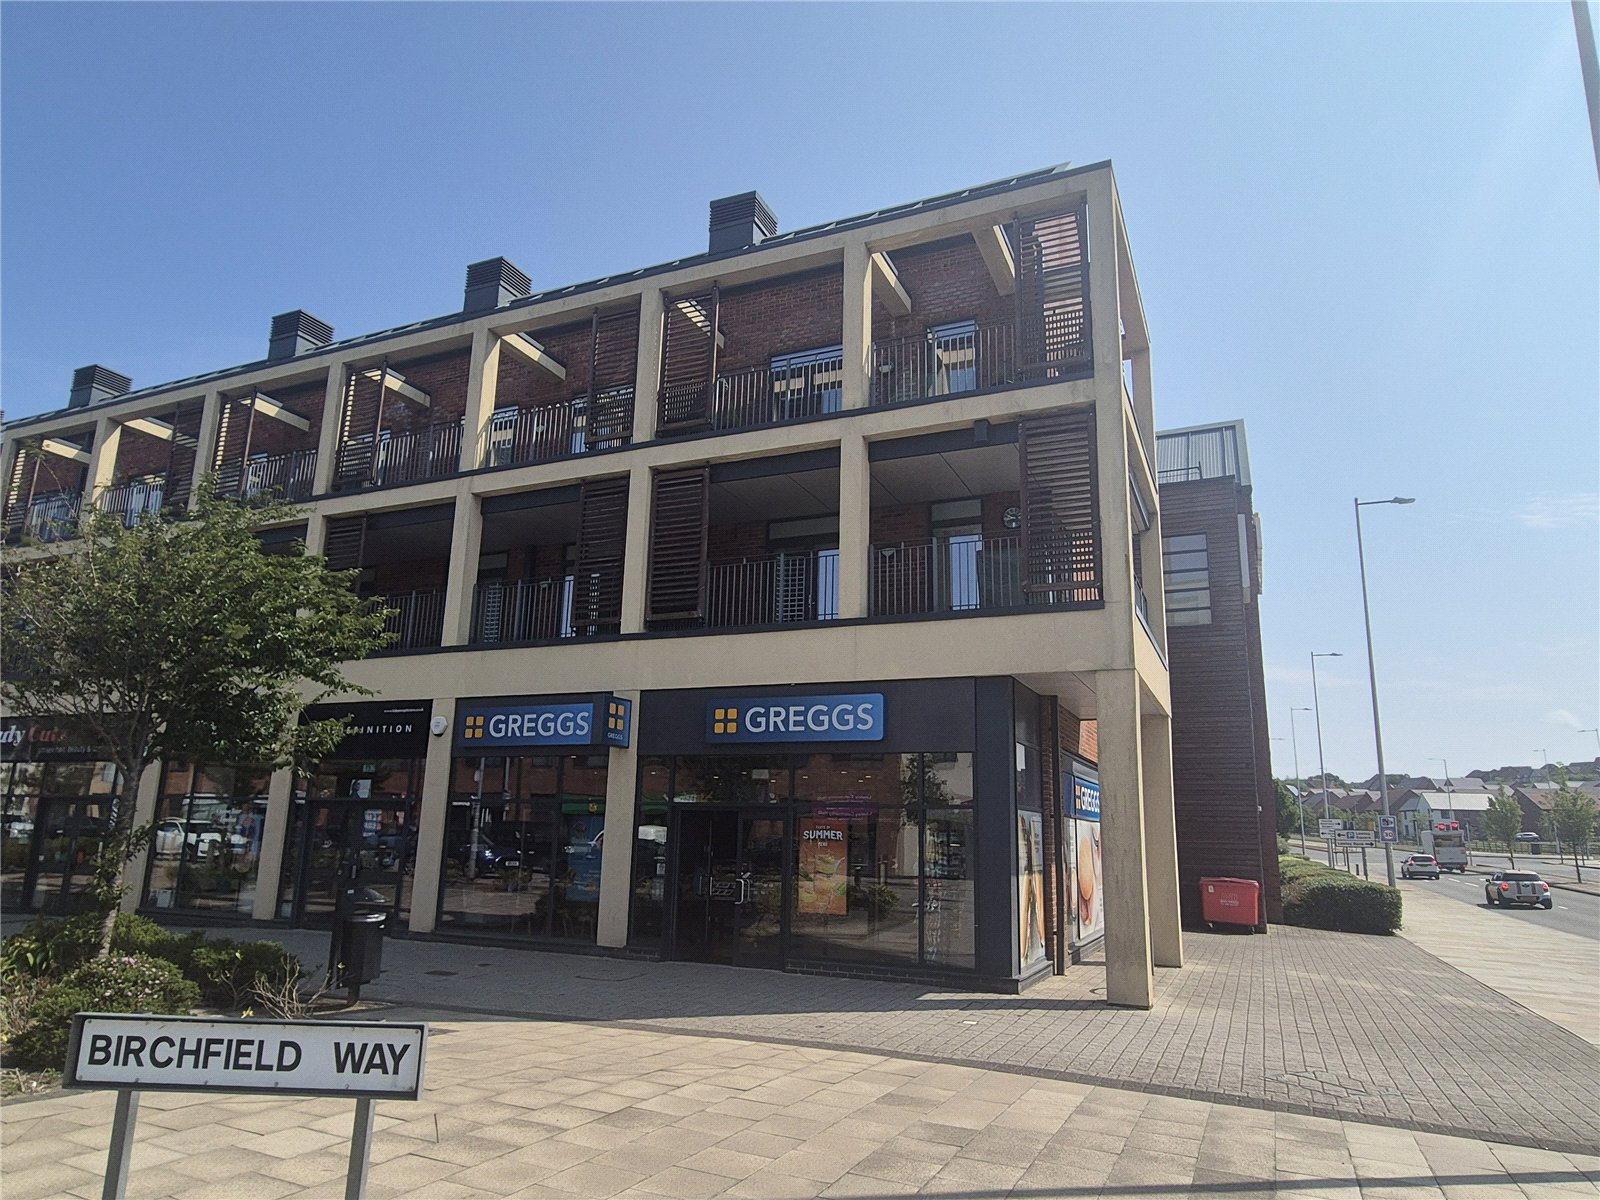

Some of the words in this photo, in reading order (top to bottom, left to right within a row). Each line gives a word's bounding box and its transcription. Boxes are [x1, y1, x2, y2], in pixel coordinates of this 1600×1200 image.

[489, 711, 589, 738] GREGGS
[745, 703, 874, 733] GREGGS
[607, 732, 624, 741] GREGGS
[1081, 786, 1100, 813] GREGGS
[803, 830, 844, 841] SUMMER
[87, 1034, 302, 1072] BIRCHFIELD
[334, 1041, 411, 1075] WAY
